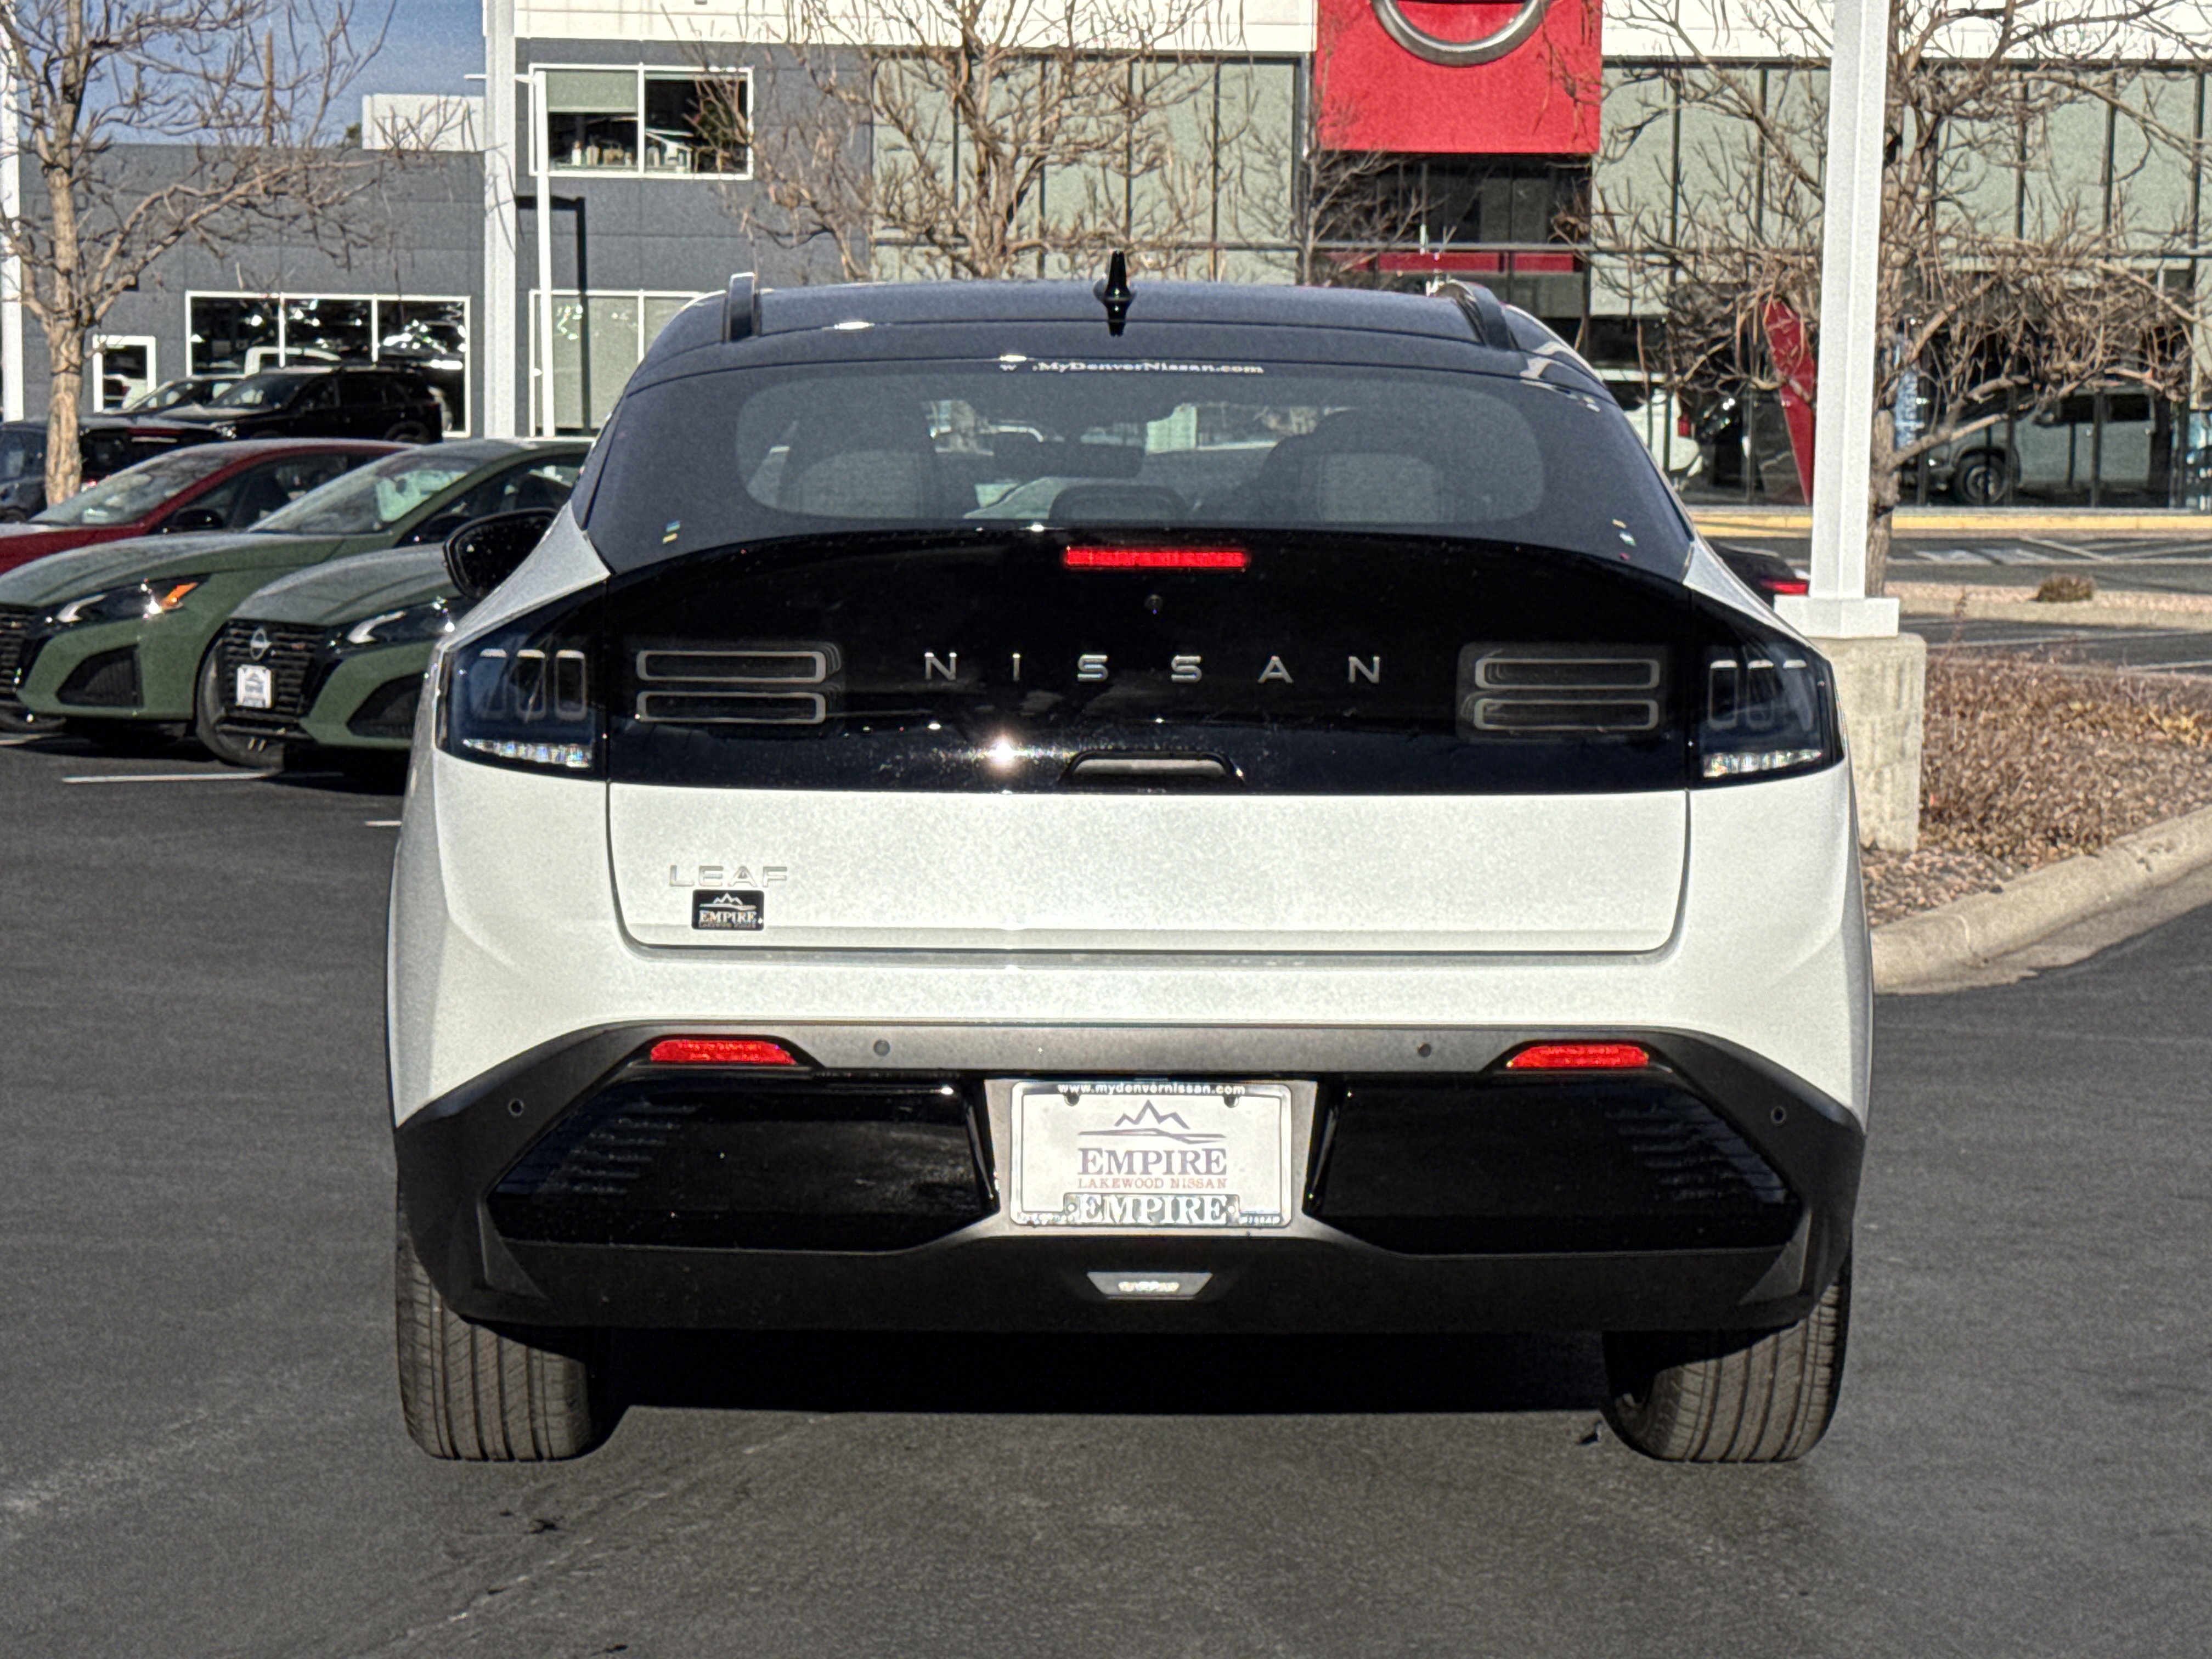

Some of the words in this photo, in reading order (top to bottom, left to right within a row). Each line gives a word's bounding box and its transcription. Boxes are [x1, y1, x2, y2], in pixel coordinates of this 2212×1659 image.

[923, 651, 1381, 684] NISSAN
[669, 865, 788, 888] LEAF
[699, 910, 757, 923] EMPIRE
[1058, 1082, 1246, 1095] www.mydenvernissan.com
[1077, 1147, 1227, 1176] EMPIRE
[1078, 1177, 1164, 1189] LAKEWOOD
[1170, 1178, 1228, 1189] NISSAN
[1078, 1195, 1227, 1224] EMPIRE
